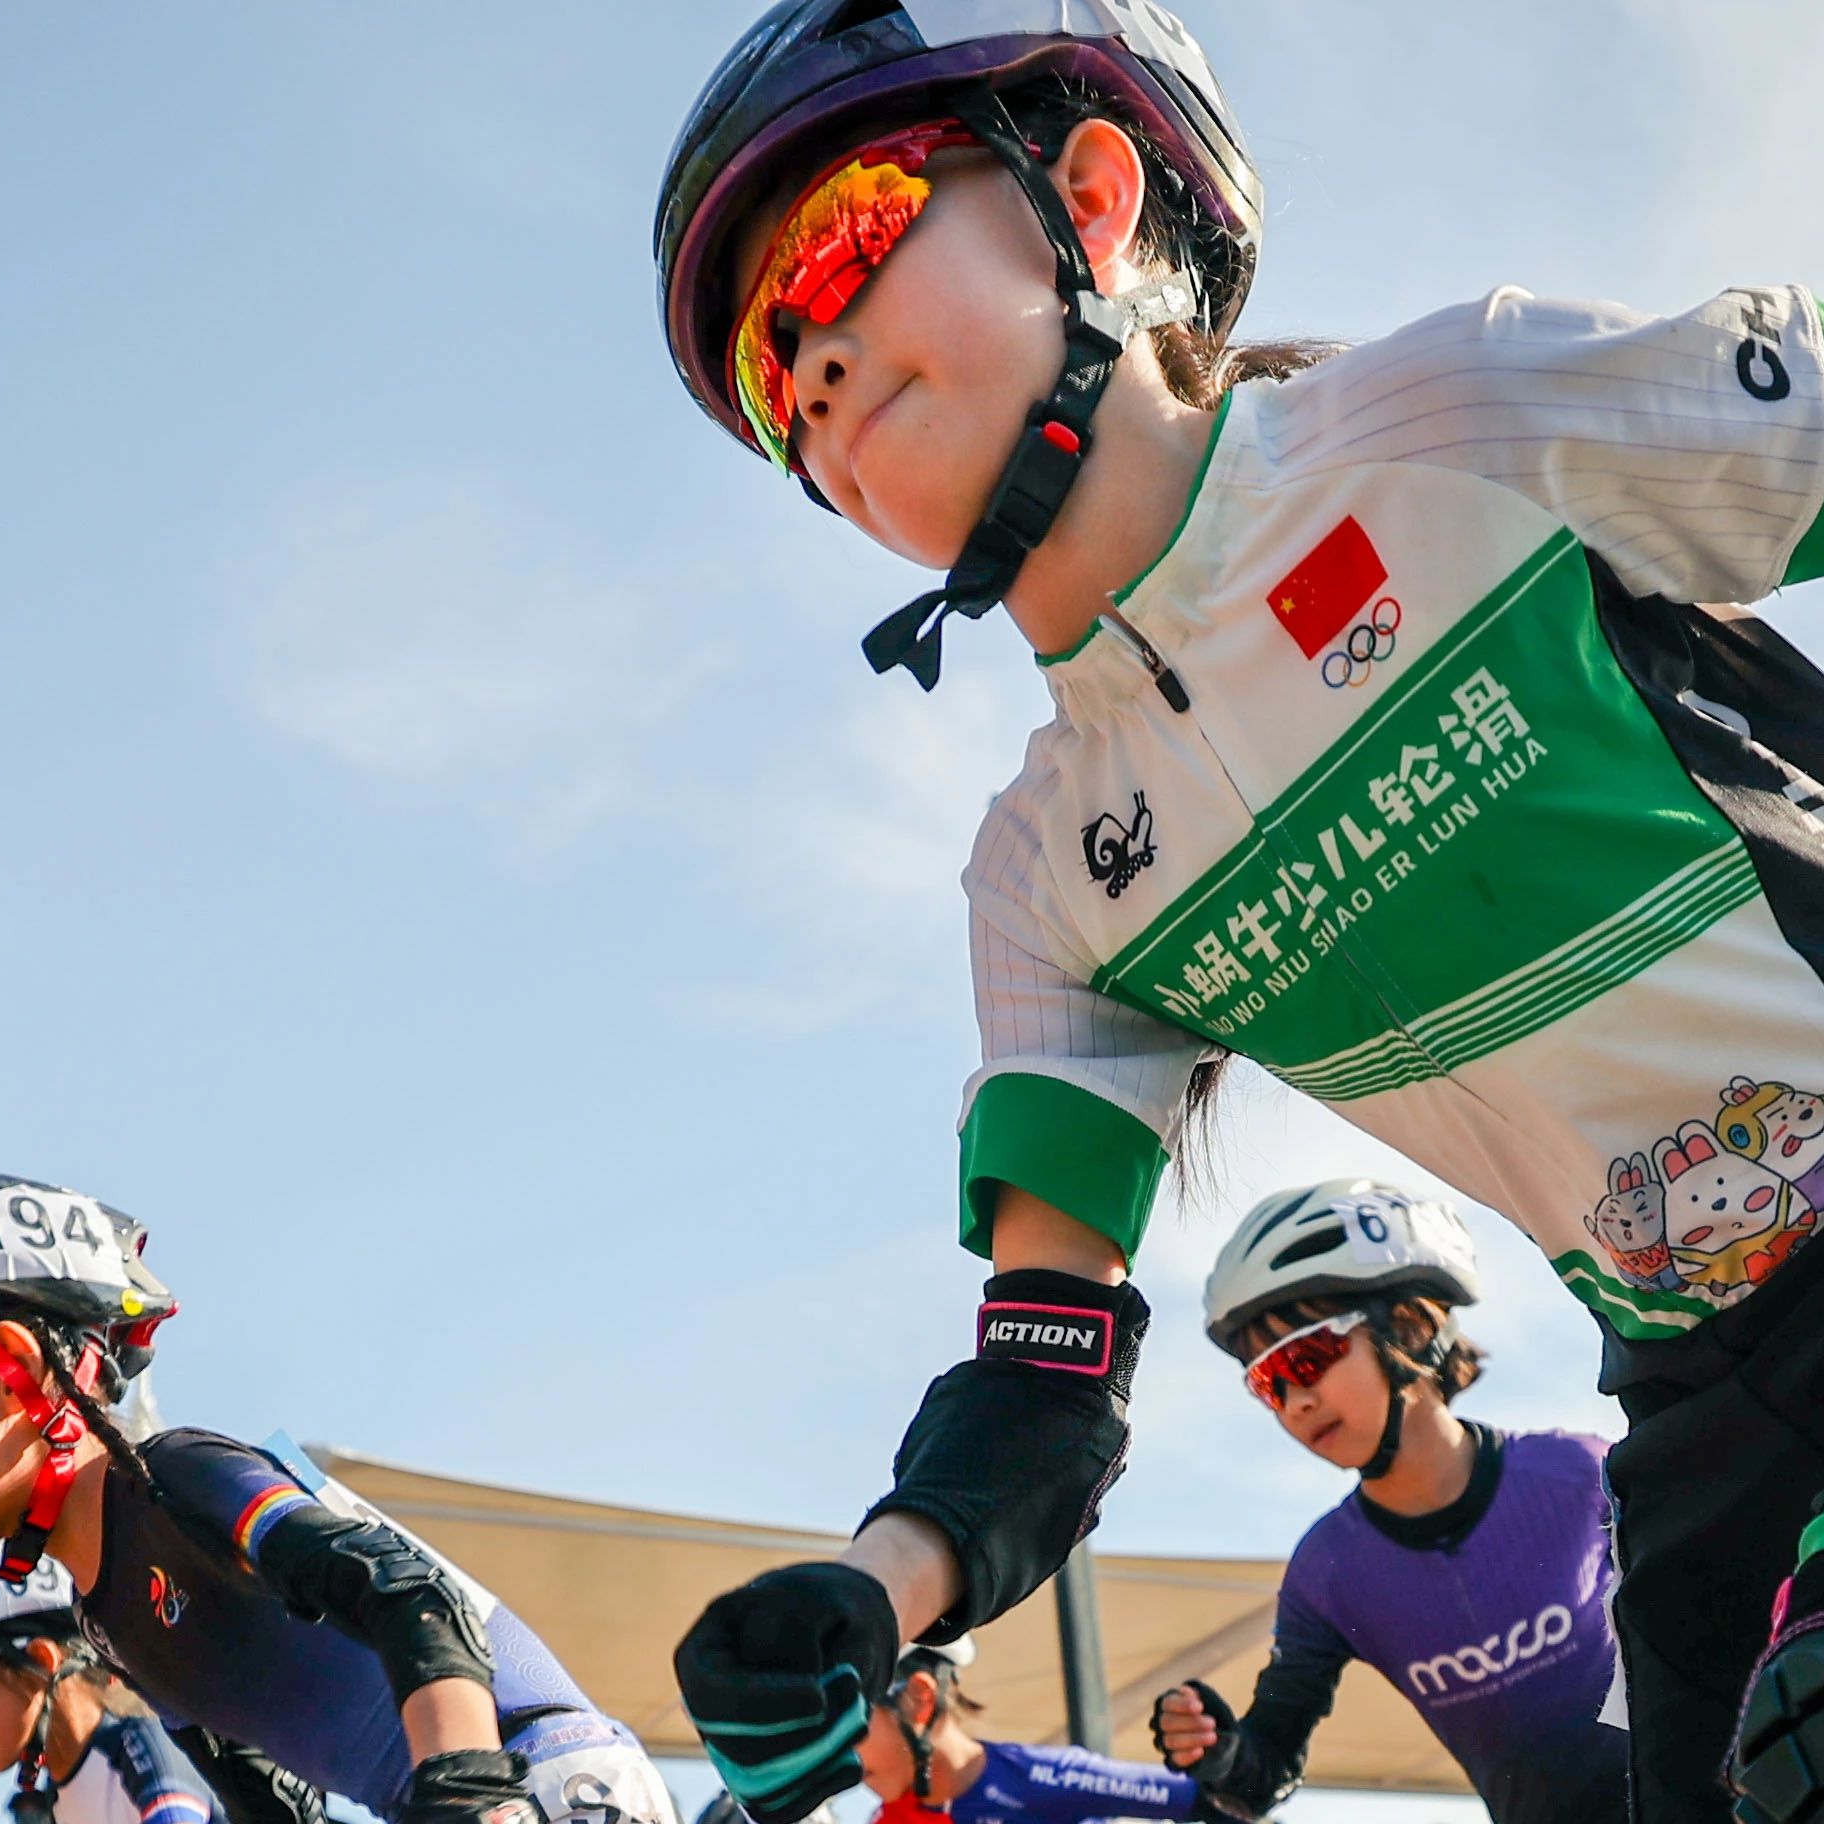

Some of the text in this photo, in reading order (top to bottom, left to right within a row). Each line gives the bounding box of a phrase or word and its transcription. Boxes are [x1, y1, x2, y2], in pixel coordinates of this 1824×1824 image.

[1229, 990, 1266, 1025] WO
[1264, 949, 1311, 997] NIU
[1375, 850, 1417, 893] ER
[1416, 793, 1480, 855] LUN
[1480, 737, 1548, 800] HUA
[982, 1319, 1097, 1350] ACTION
[1028, 1764, 1171, 1805] NL-PREMIUM
